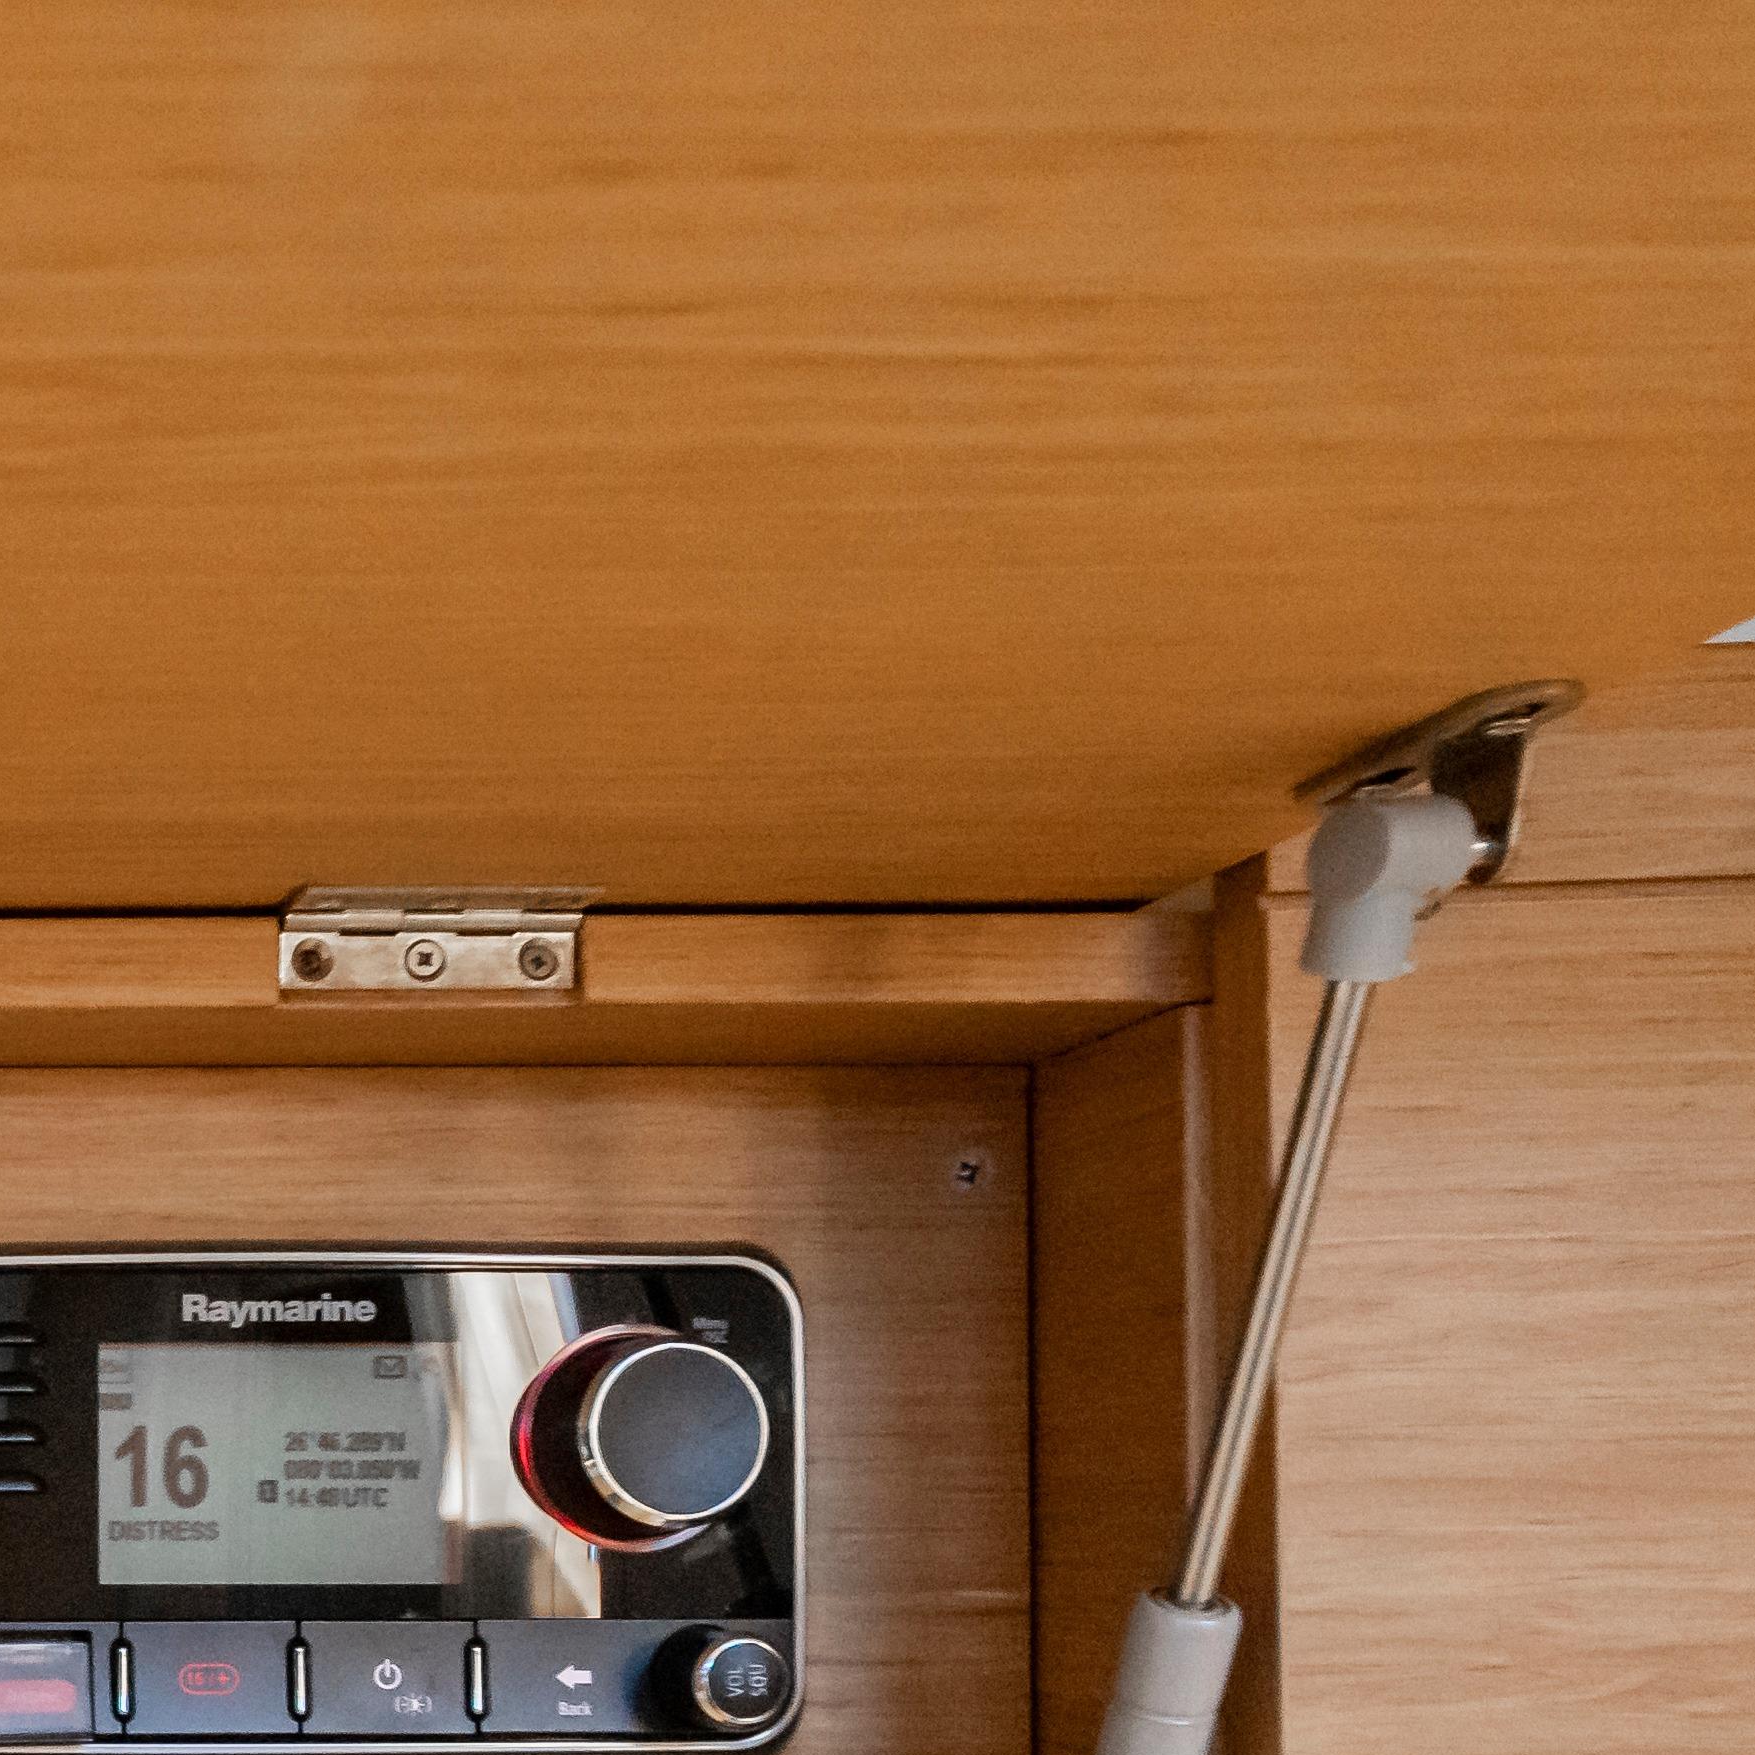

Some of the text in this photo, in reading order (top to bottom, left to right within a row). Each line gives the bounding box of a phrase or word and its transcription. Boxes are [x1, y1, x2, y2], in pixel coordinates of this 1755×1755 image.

[182, 1292, 378, 1328] Raymarine
[114, 1425, 209, 1509] 16
[107, 1520, 219, 1541] DISTRESS
[726, 1667, 745, 1696] VOL
